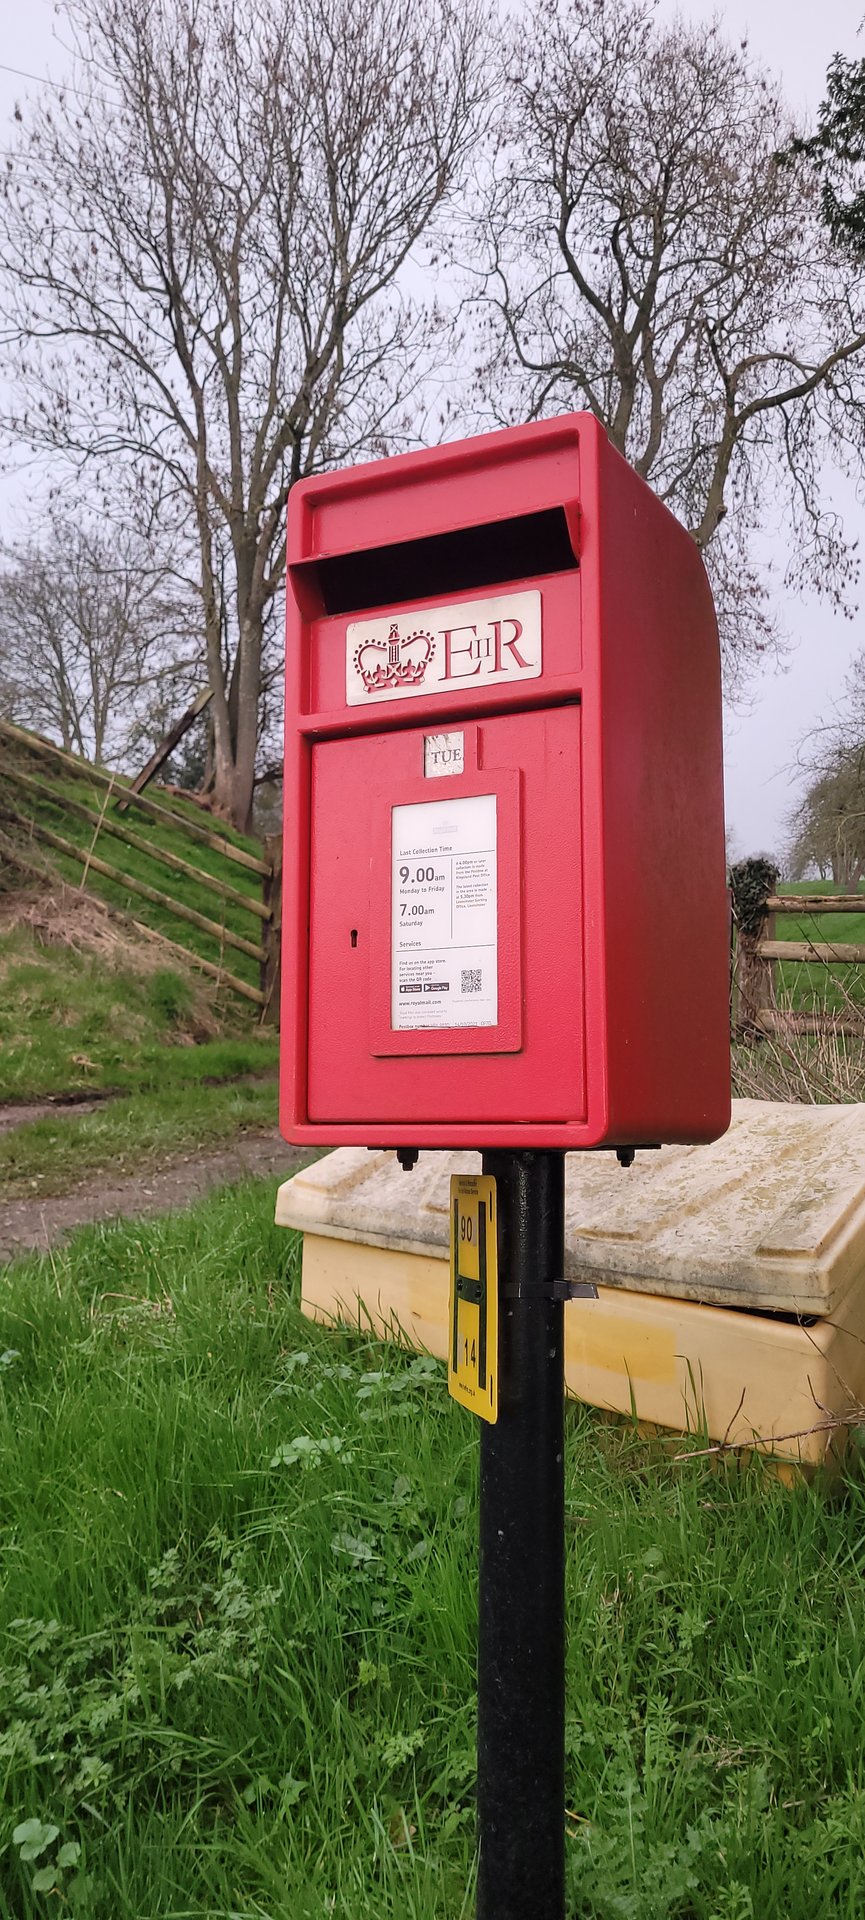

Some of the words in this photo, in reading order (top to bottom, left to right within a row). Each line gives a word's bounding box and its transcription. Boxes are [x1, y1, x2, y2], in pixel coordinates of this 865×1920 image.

[431, 748, 462, 764] TUE
[400, 866, 446, 884] 9.00am
[400, 904, 434, 916] 7.00am
[461, 1216, 473, 1242] 90
[464, 1338, 476, 1368] 14
